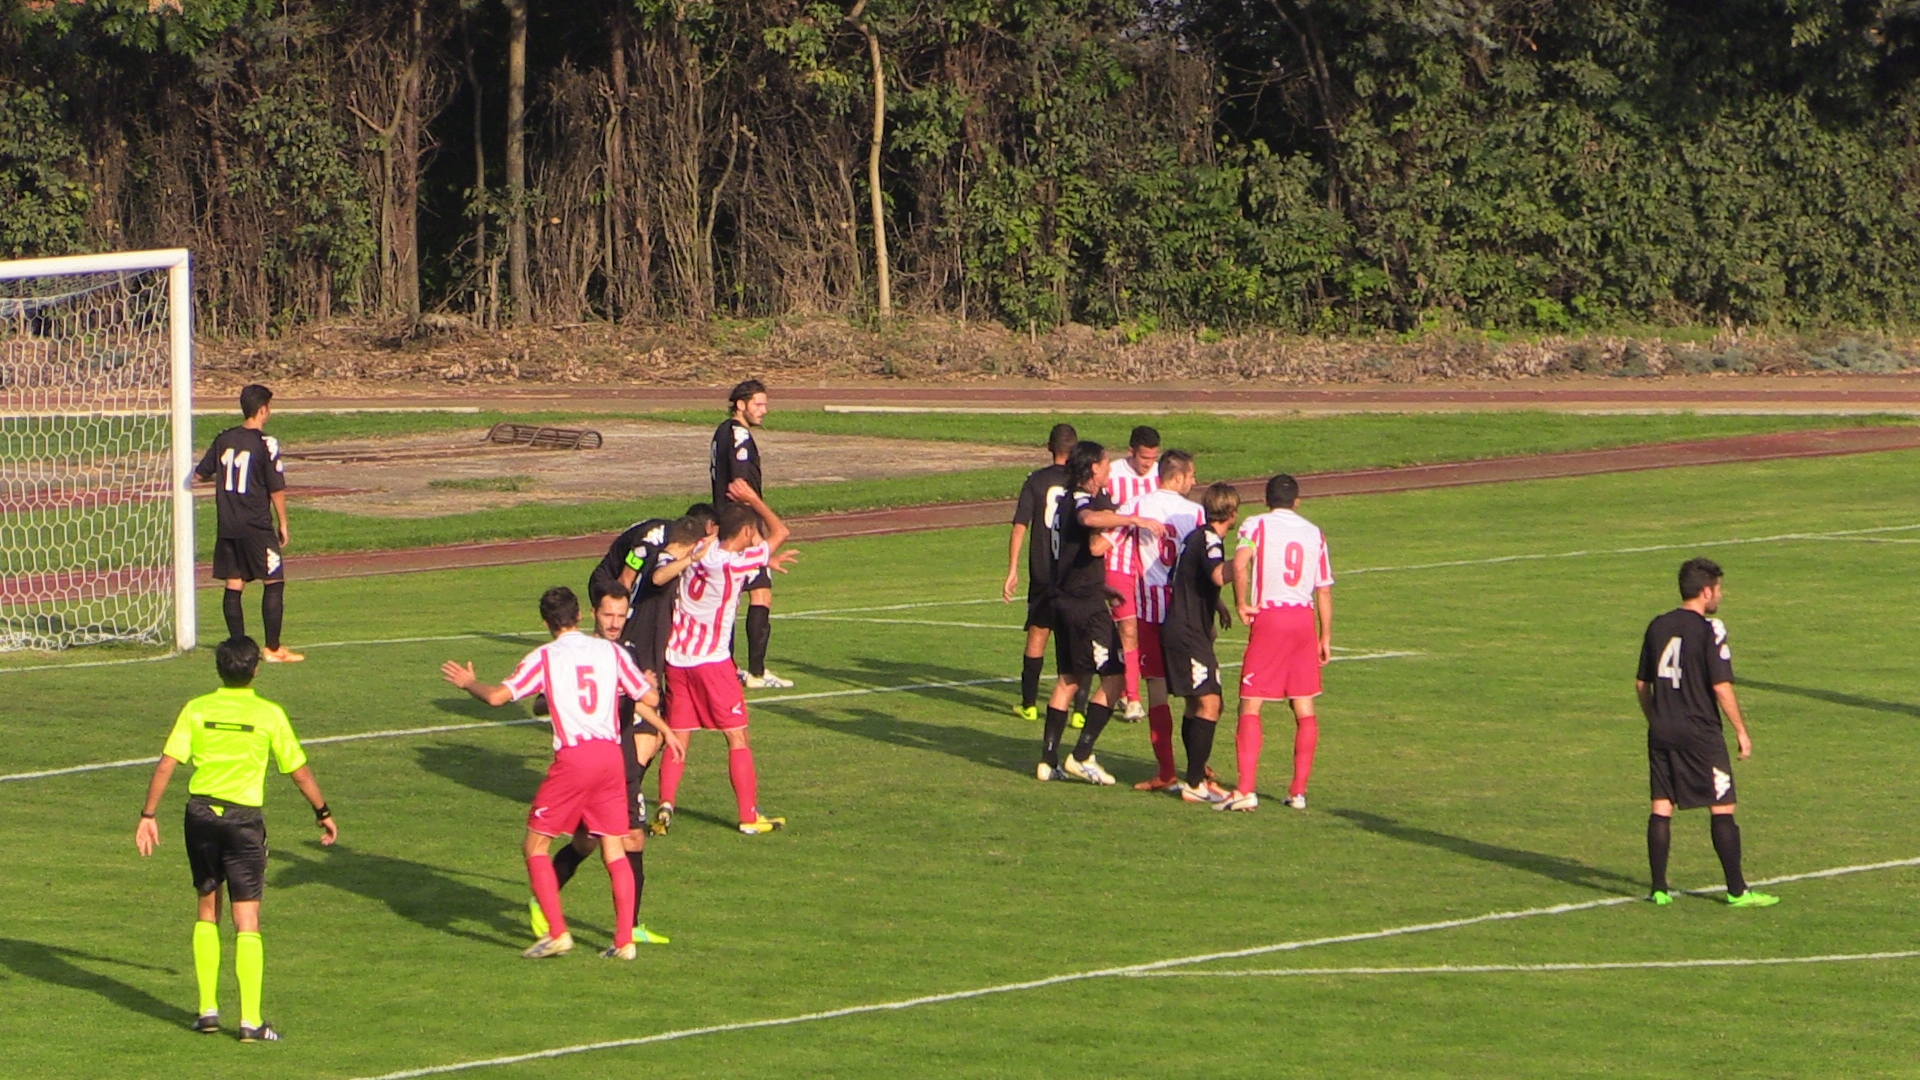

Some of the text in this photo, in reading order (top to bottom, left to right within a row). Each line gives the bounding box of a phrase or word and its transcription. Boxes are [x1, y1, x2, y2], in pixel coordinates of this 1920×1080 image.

[220, 448, 251, 494] 11
[1158, 523, 1177, 567] 6
[1283, 541, 1304, 587] 9
[1657, 636, 1683, 689] 4
[575, 665, 598, 715] 5
